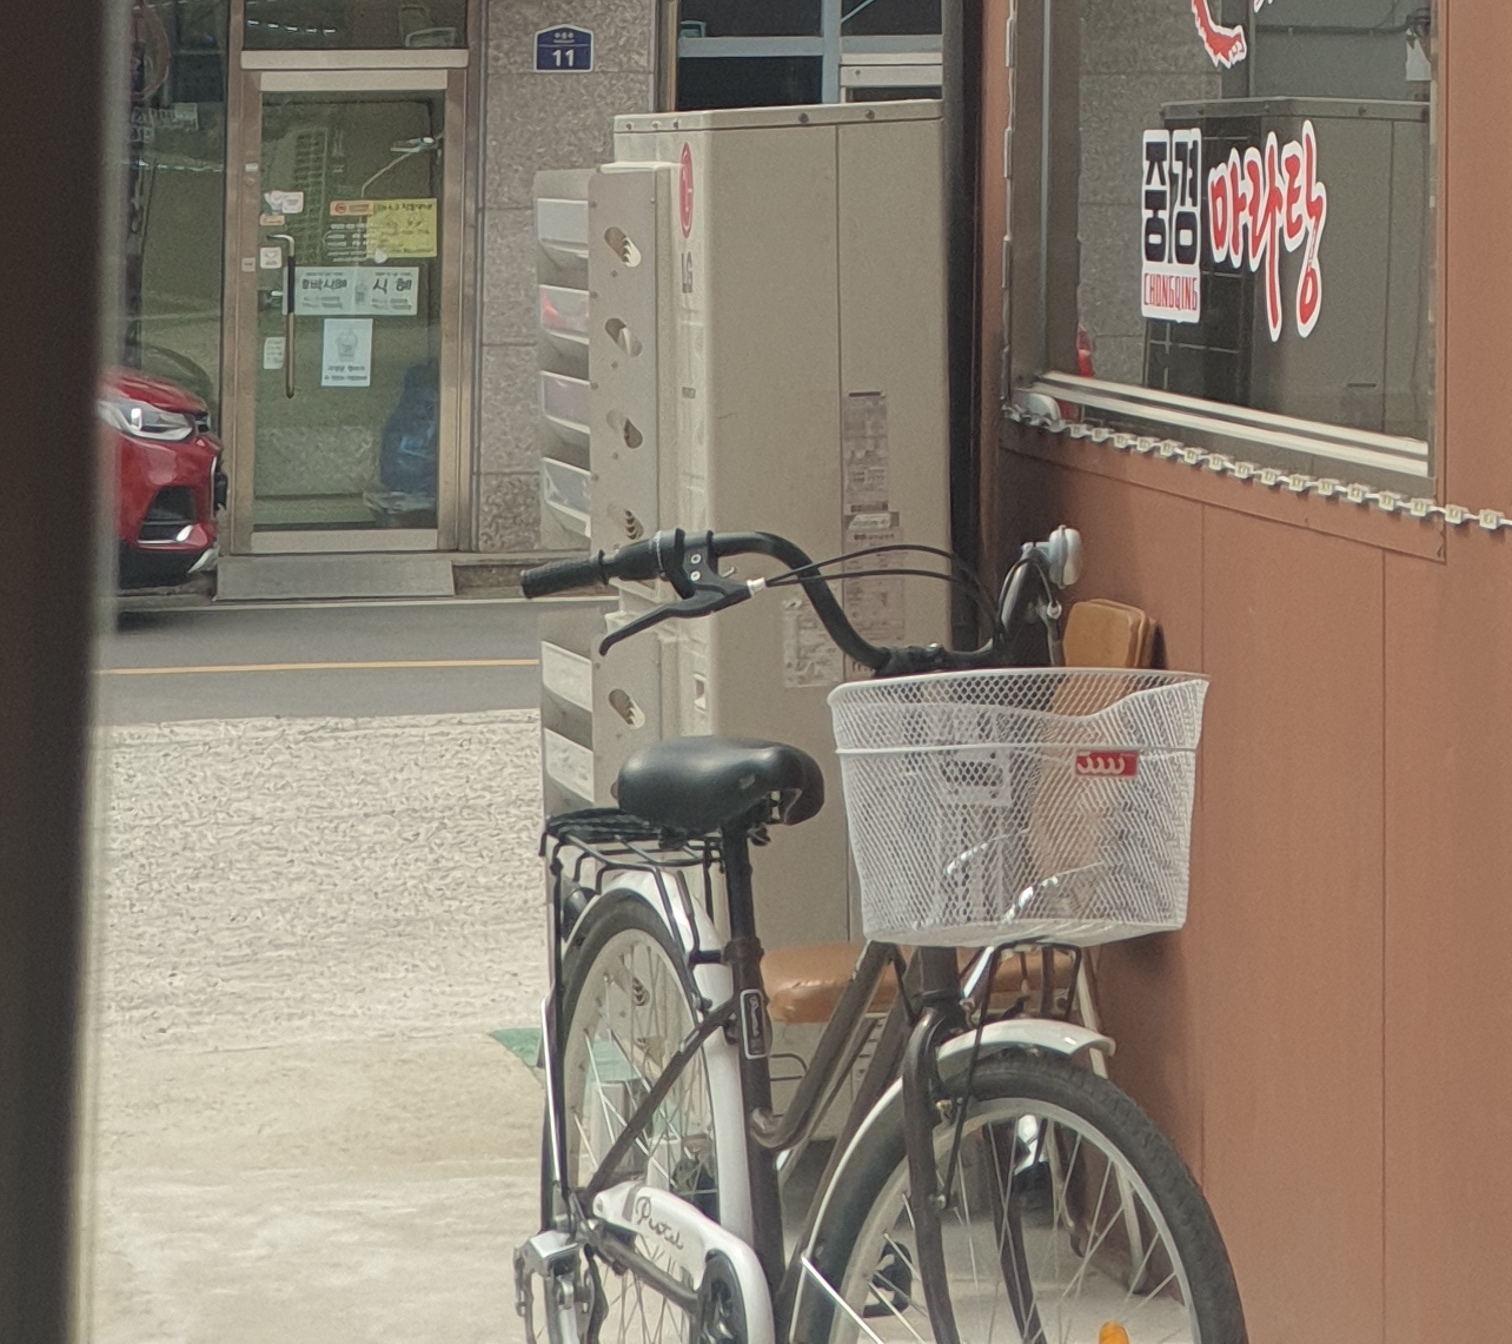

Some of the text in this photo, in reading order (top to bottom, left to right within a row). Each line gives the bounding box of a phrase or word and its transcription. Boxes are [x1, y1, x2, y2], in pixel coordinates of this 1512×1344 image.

[552, 49, 574, 67] 11
[1144, 127, 1324, 336] 중경 마라탕
[681, 250, 693, 294] LG
[1144, 273, 1198, 311] CHONGQING
